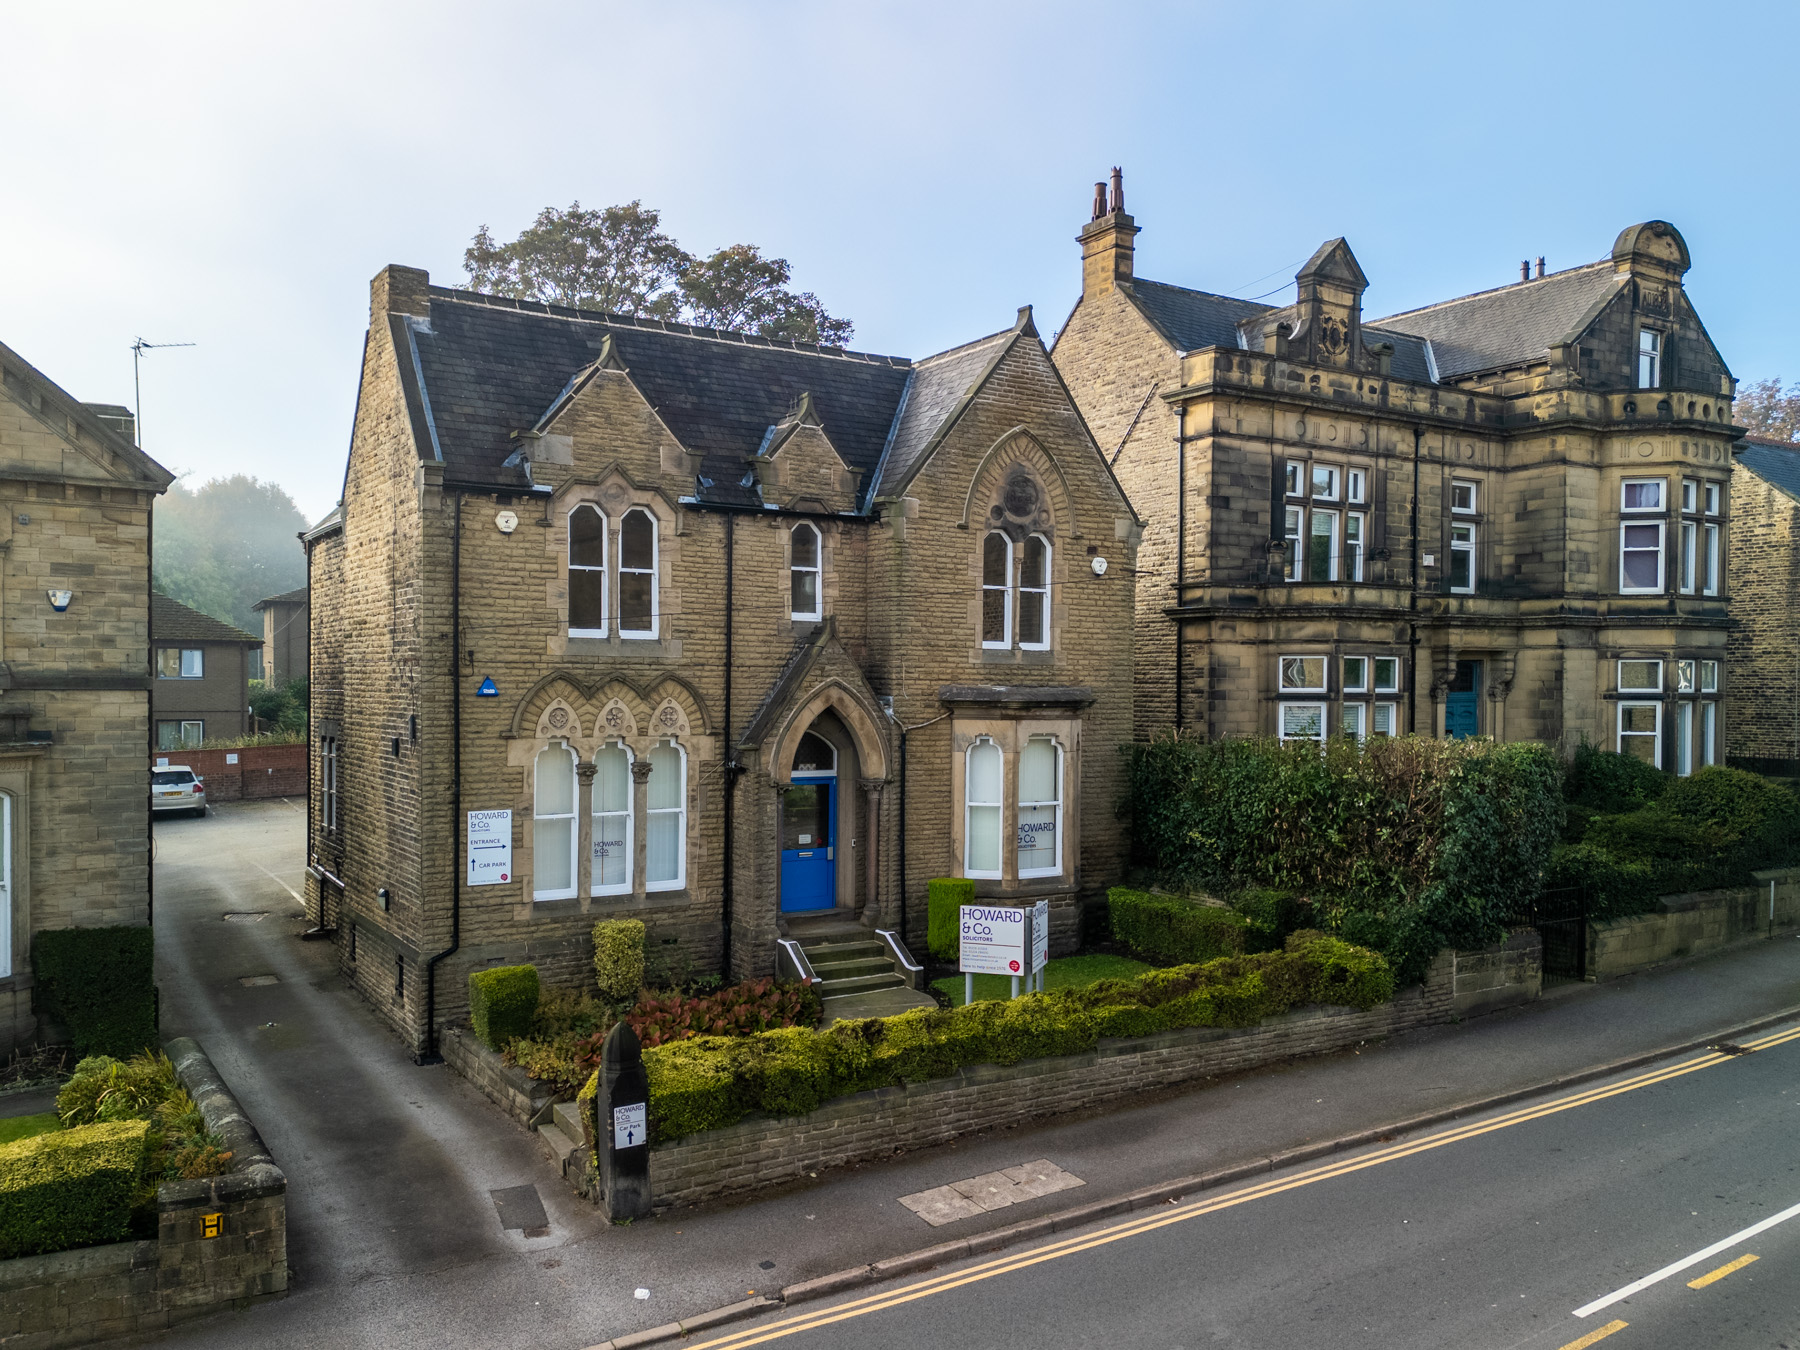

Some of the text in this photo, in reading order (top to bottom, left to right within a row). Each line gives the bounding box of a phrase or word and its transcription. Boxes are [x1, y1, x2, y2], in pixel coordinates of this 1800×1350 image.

[470, 811, 509, 820] HOWARD
[1018, 822, 1055, 832] HOWARD
[1024, 834, 1036, 843] Co.
[962, 908, 1023, 923] HOWARD
[962, 922, 993, 936] & Co.
[615, 1104, 644, 1115] HOWARD
